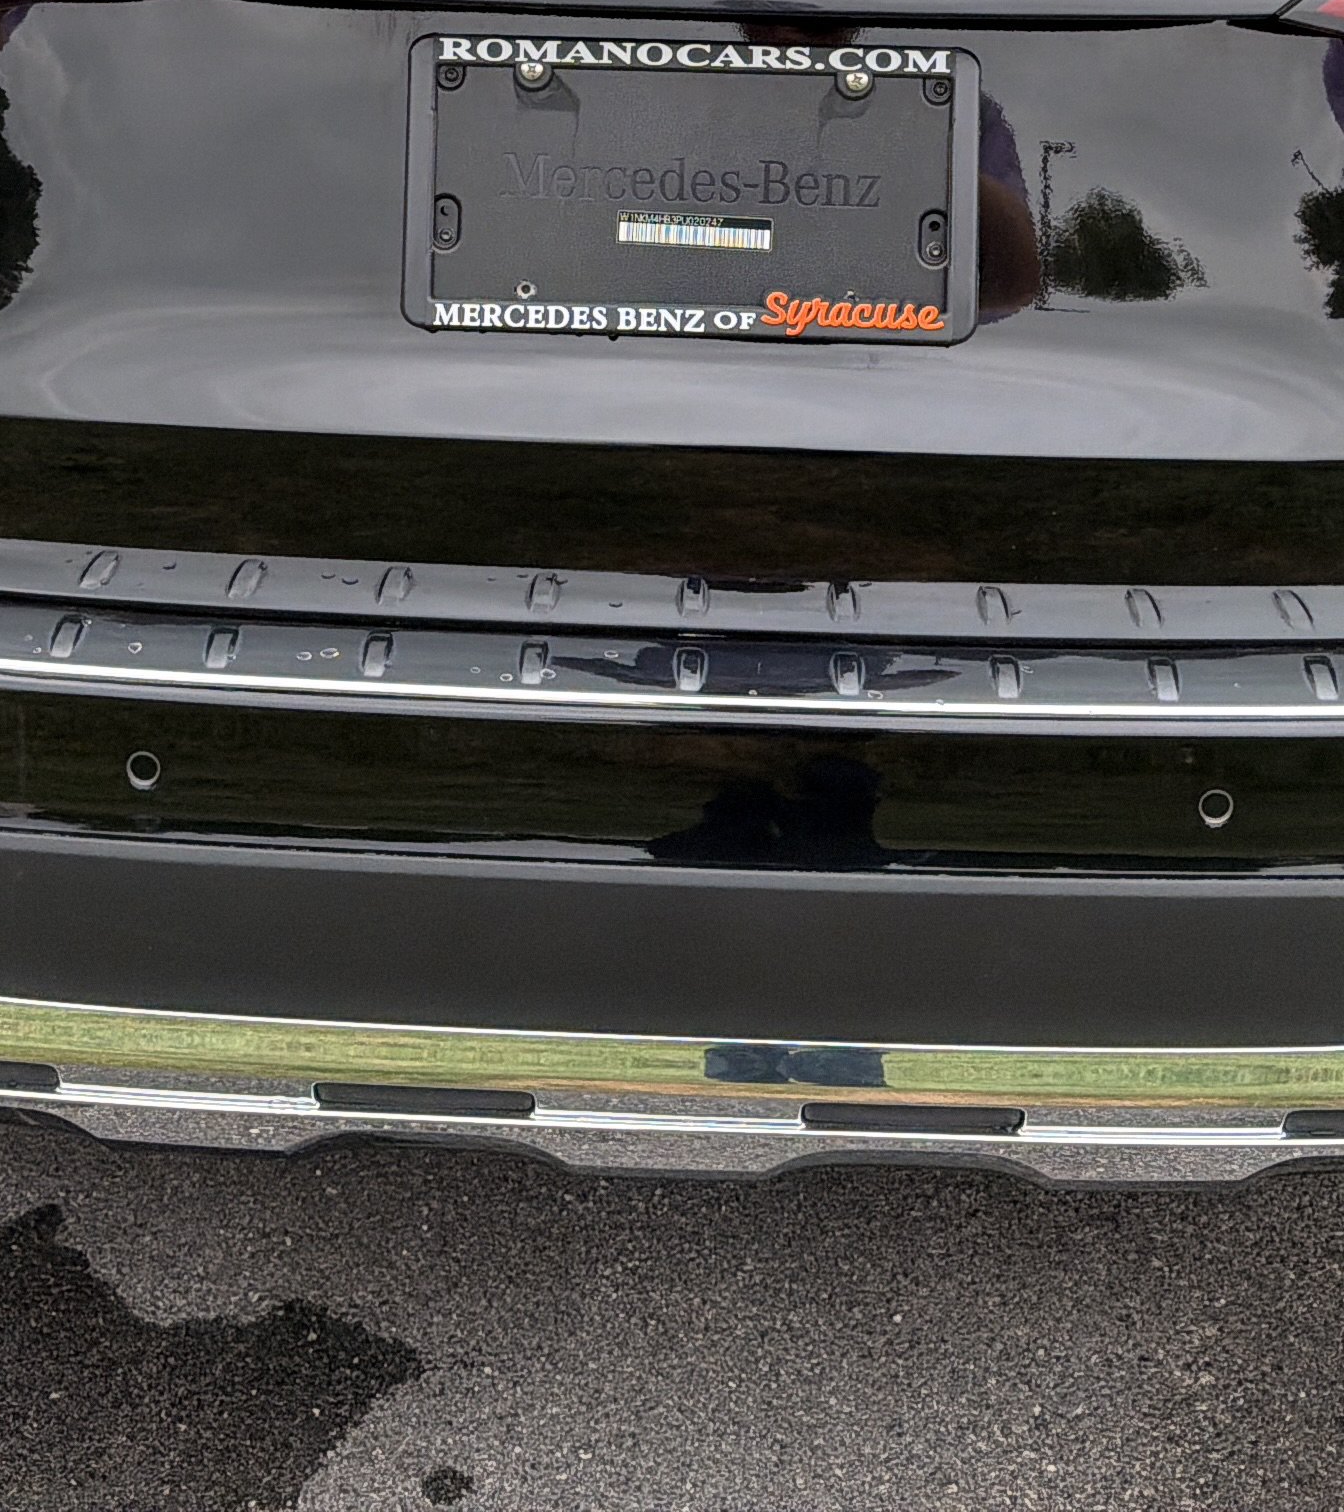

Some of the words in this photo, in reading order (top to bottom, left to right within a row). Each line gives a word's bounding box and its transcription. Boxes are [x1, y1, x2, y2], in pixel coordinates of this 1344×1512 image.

[438, 36, 952, 75] ROMANOCARS.COM
[499, 151, 882, 209] Mercedes-Benz
[433, 302, 608, 331] MERCEDES
[616, 306, 705, 333] BENZ
[713, 310, 757, 331] OF
[760, 291, 946, 337] Syracuse
